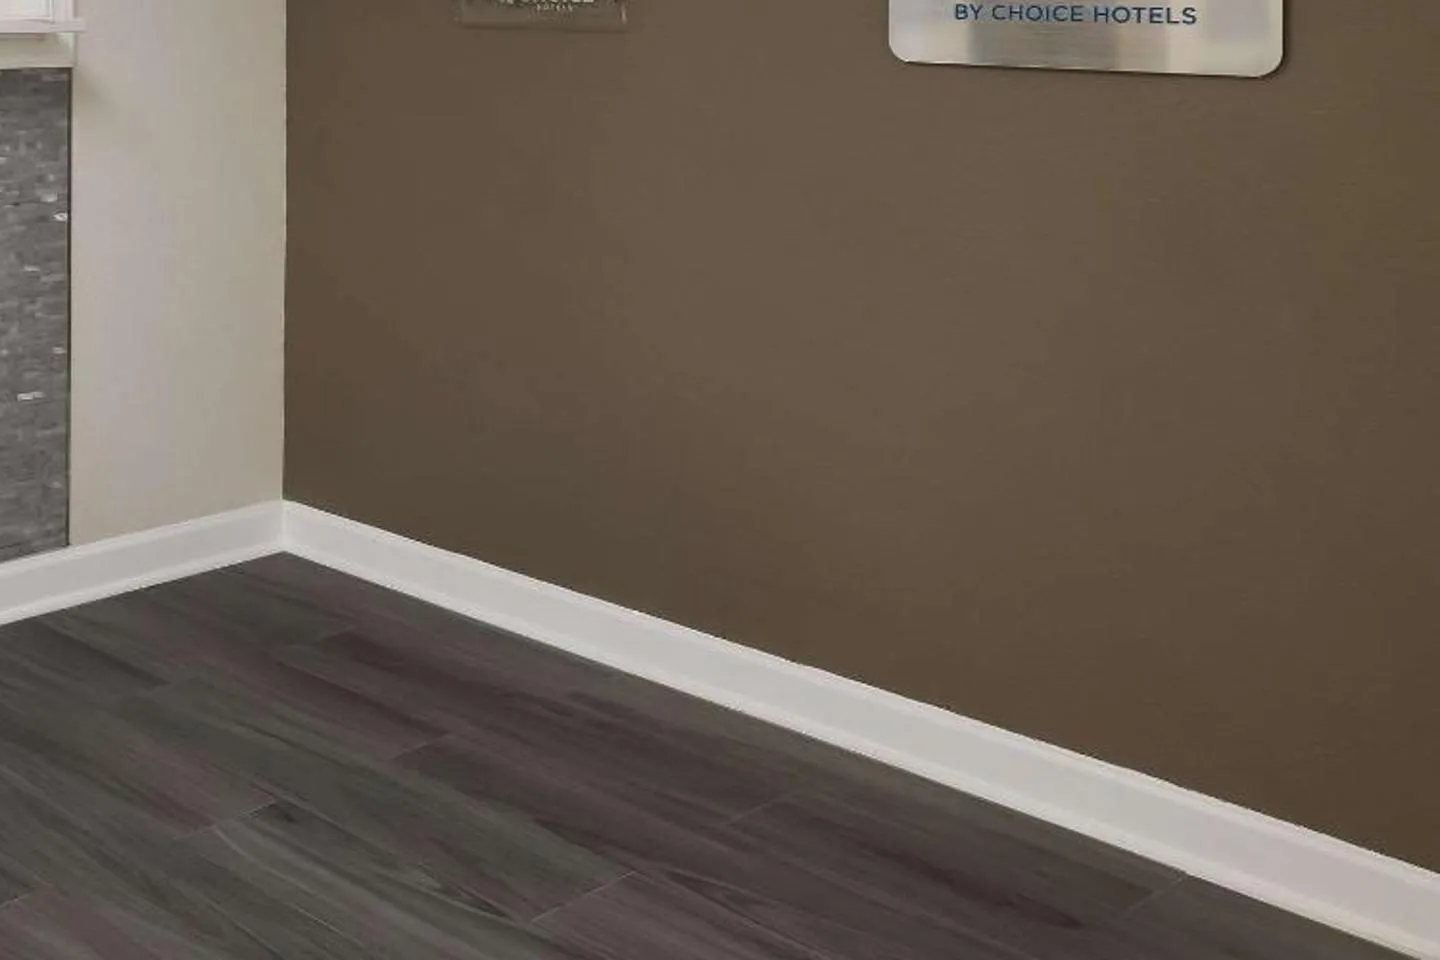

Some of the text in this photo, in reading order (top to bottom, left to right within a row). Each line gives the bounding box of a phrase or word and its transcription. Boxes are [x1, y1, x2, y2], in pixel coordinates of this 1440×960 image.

[955, 4, 1198, 25] BY CHOICE HOTELS
